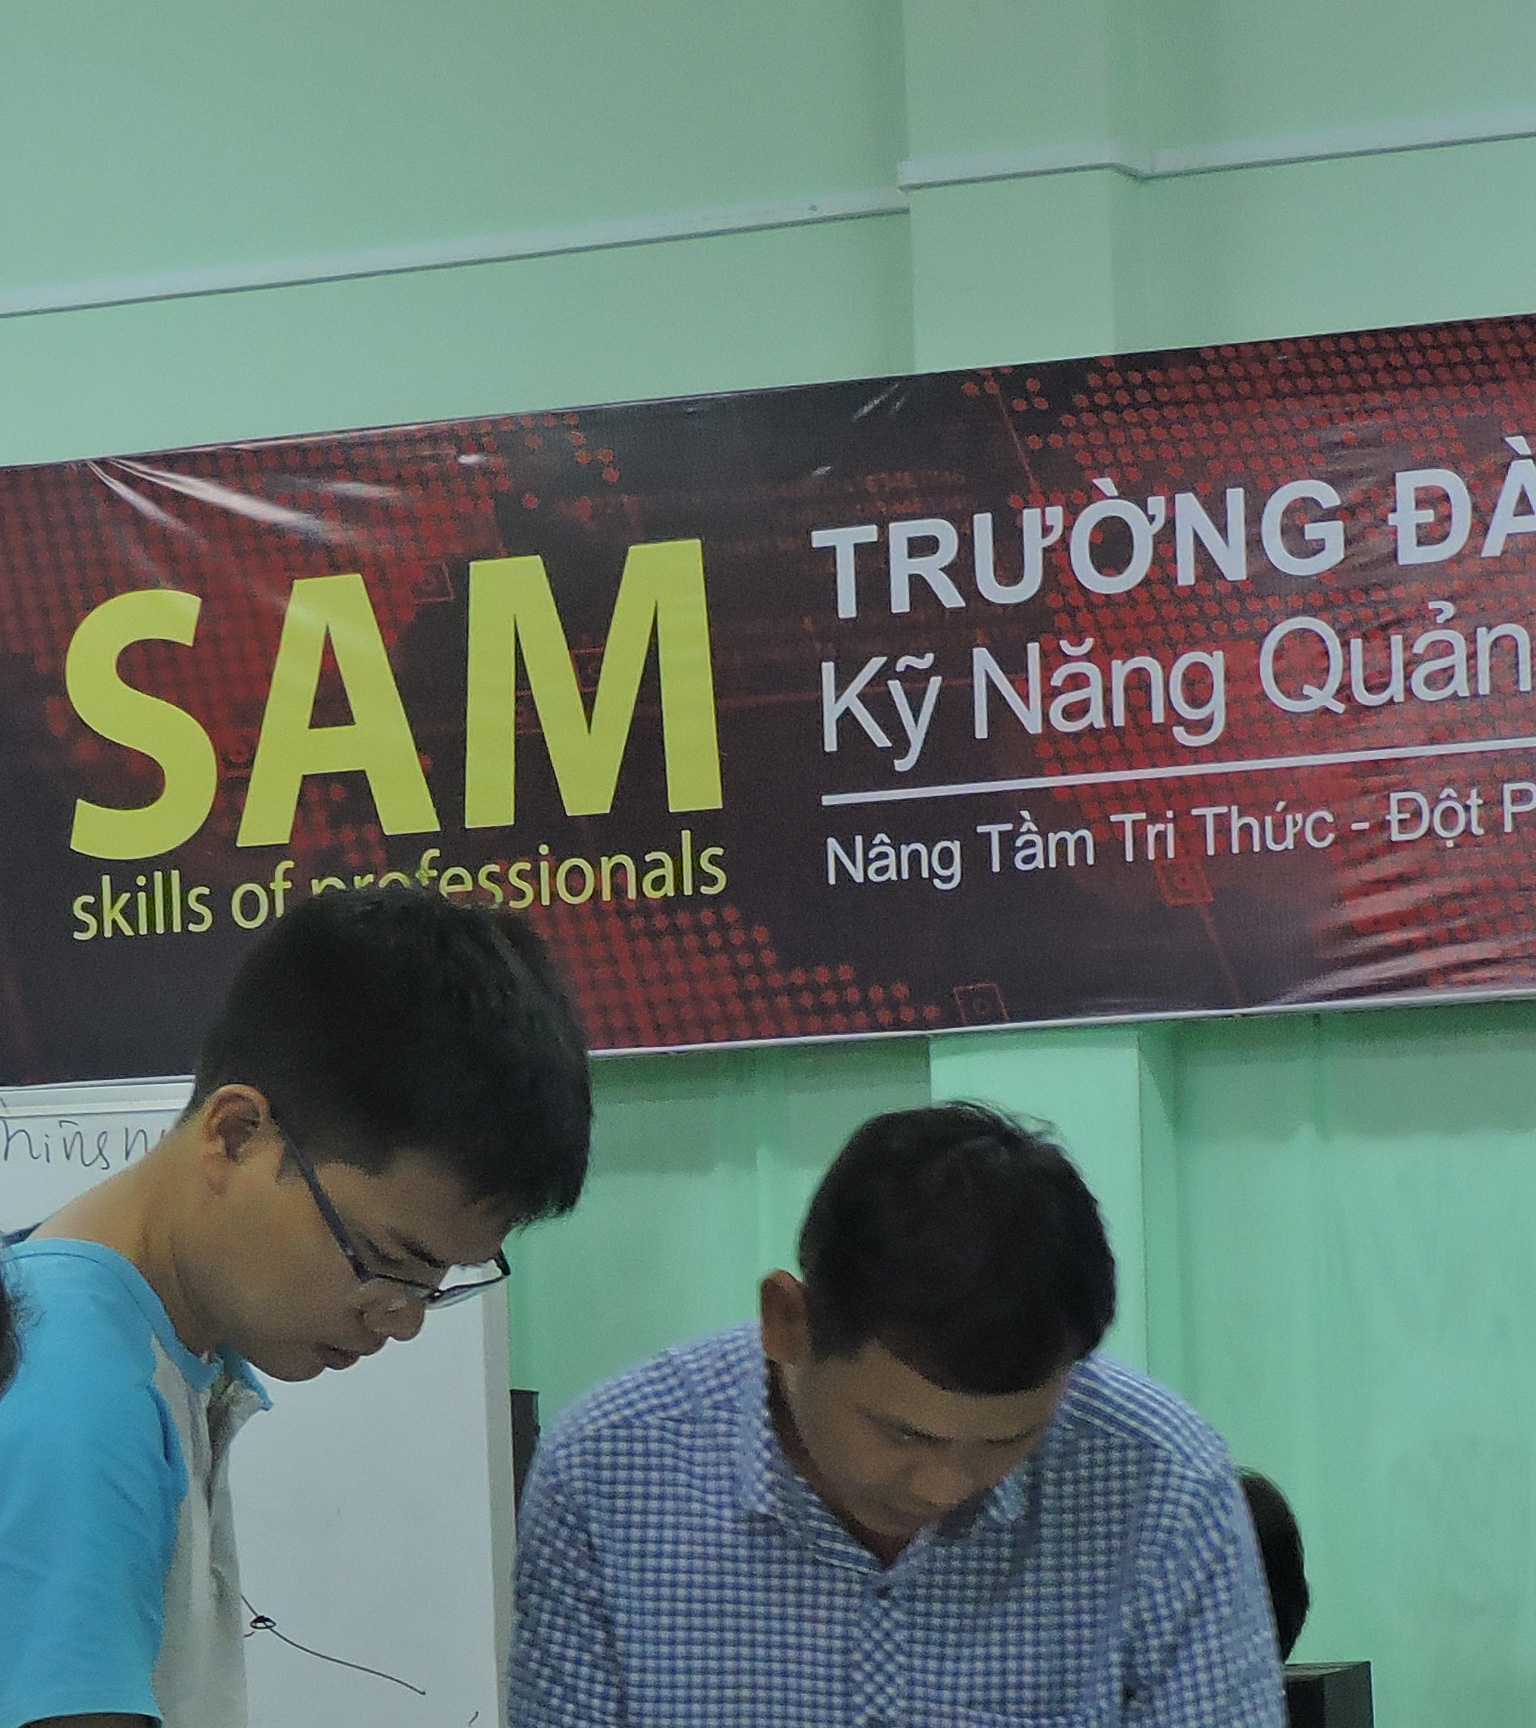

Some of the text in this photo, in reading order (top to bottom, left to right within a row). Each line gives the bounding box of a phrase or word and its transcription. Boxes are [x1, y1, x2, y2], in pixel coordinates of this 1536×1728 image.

[812, 478, 1344, 618] TRƯỜNG
[66, 539, 722, 859] SAM
[822, 653, 942, 771] Kỹ
[973, 638, 1225, 746] Năng
[1260, 601, 1531, 713] Quản
[72, 830, 726, 939] skills of fessionals
[827, 834, 961, 889] Nâng
[977, 811, 1093, 872] Tầm
[1110, 811, 1174, 861] Tri
[1192, 801, 1334, 855] Thức
[1386, 788, 1484, 847] Đột
